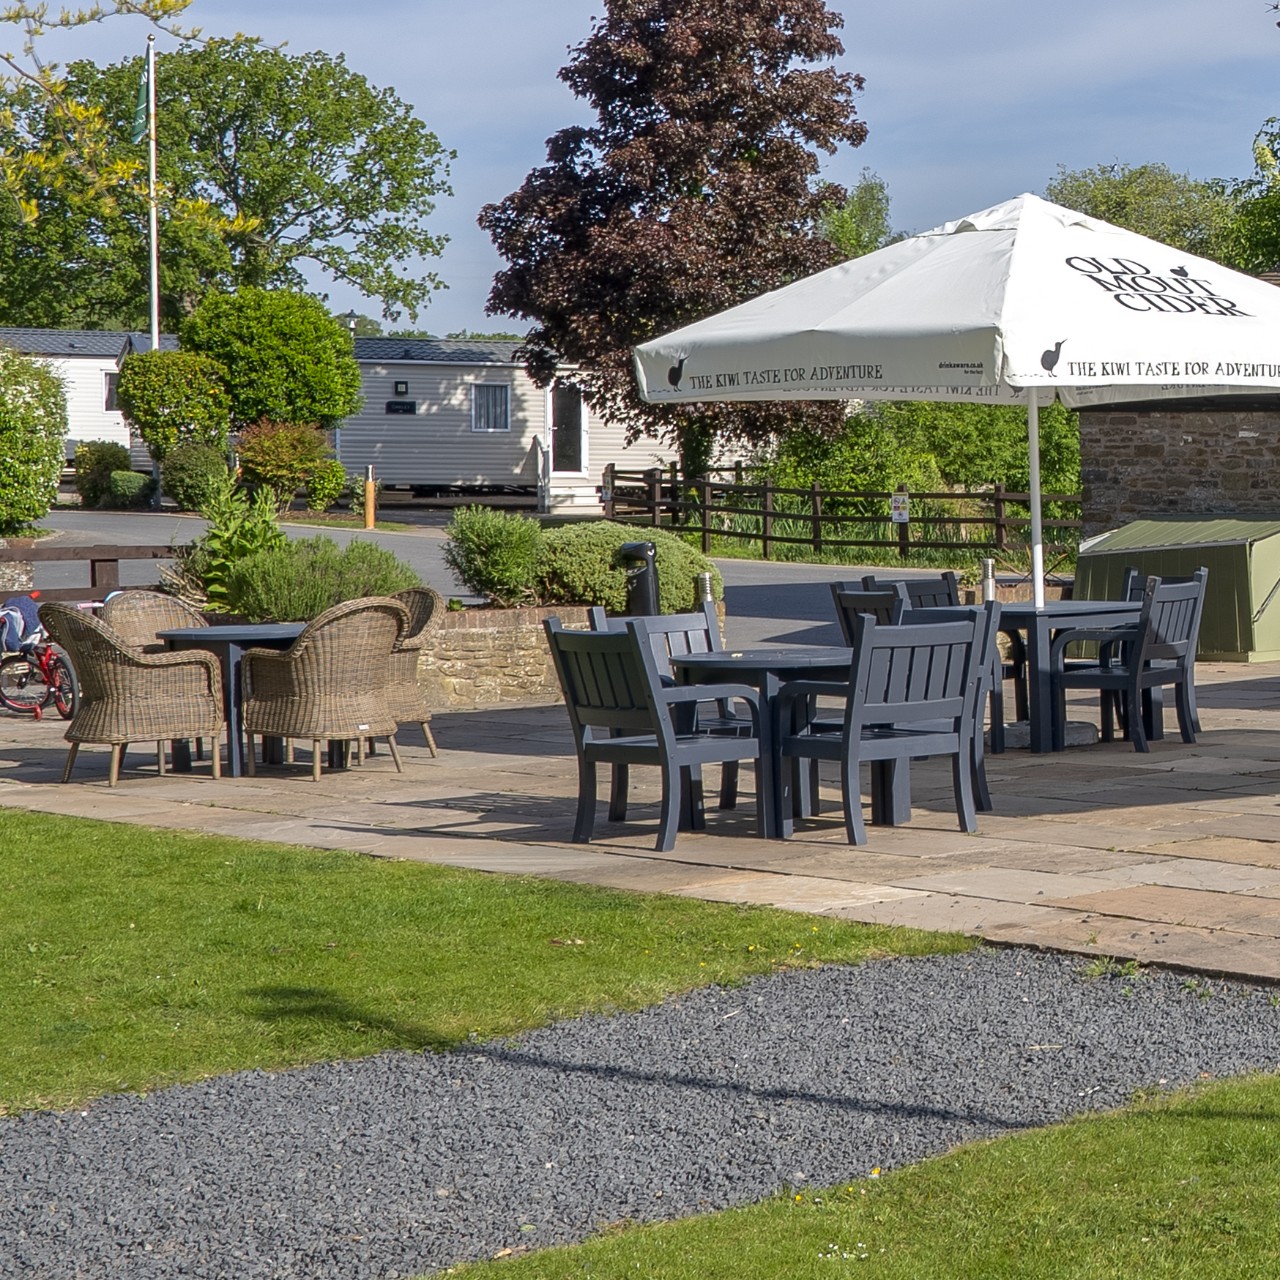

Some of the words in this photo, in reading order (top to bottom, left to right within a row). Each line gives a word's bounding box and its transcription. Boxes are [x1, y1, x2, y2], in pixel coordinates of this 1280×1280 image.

[1065, 256, 1151, 275] OLD
[1081, 274, 1221, 297] MOUT
[1113, 293, 1257, 317] CIDER
[690, 375, 712, 389] THE
[716, 372, 740, 387] KIWI
[743, 369, 780, 385] TASTE
[784, 367, 806, 382] FOR
[810, 364, 883, 381] ADVENTURE
[1067, 361, 1097, 376] THE
[1101, 361, 1131, 376] KIWI
[1135, 362, 1180, 376] TASTE
[1185, 362, 1210, 376] FOR
